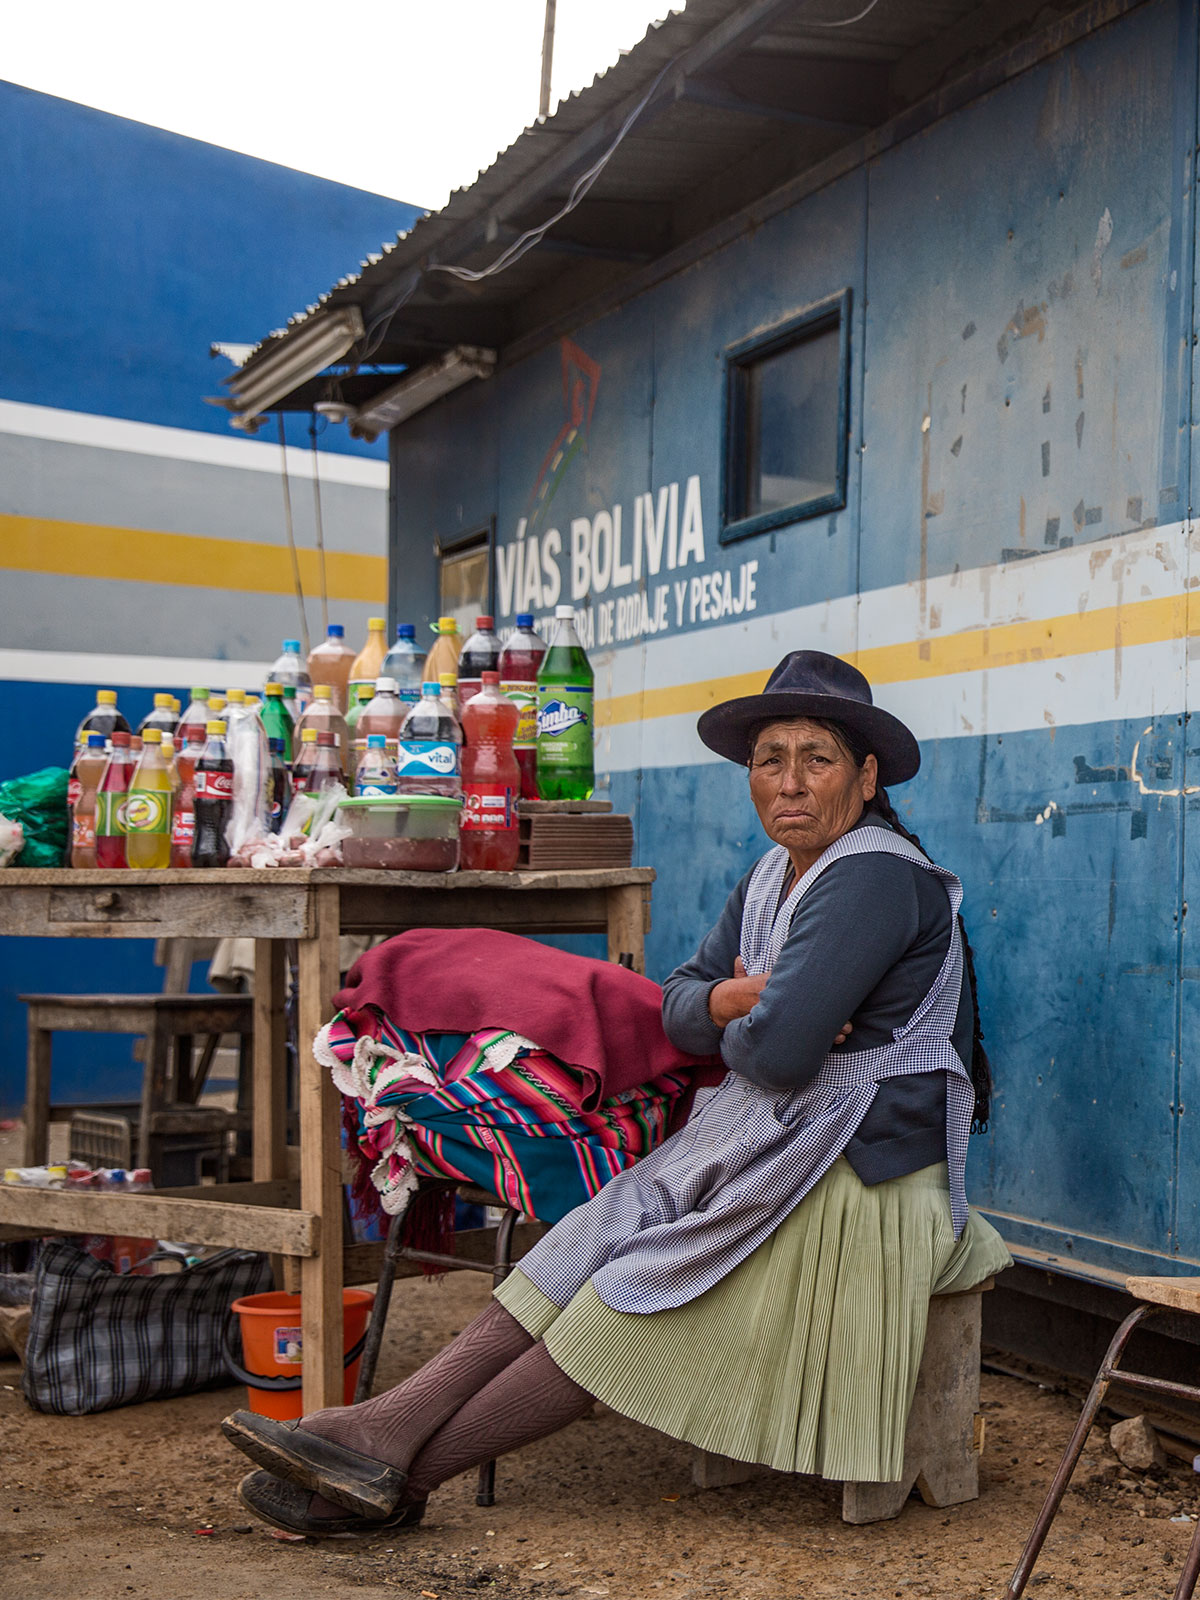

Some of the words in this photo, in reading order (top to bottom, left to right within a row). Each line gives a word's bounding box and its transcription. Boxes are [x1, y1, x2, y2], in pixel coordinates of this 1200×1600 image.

[496, 517, 562, 617] VÍAS
[571, 474, 705, 601] BOLIVIA
[598, 600, 614, 646] DE
[616, 584, 670, 643] RODAJE
[674, 581, 687, 627] Y
[689, 560, 759, 622] PESAJE
[428, 752, 453, 764] vital
